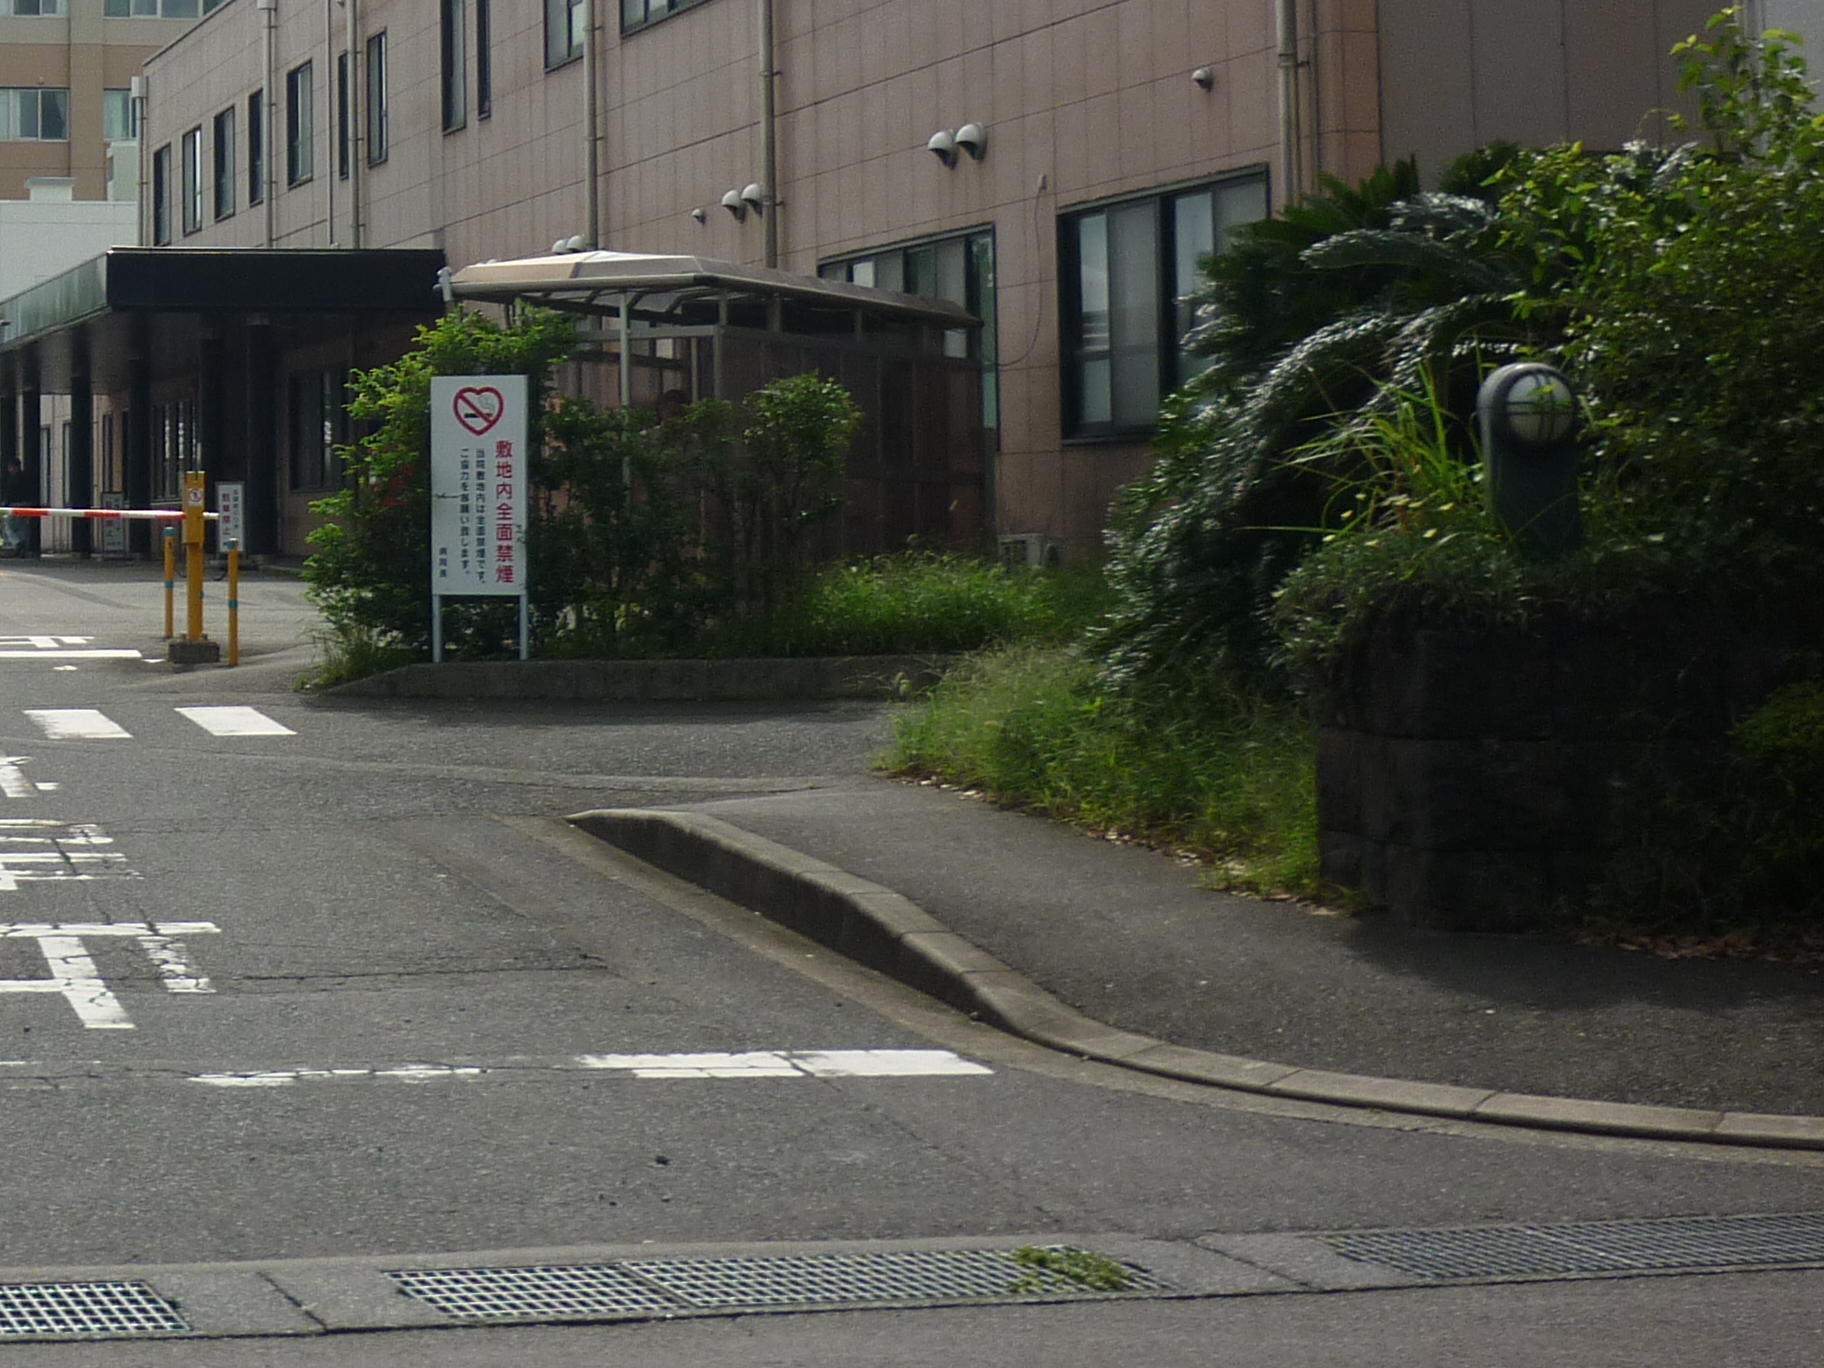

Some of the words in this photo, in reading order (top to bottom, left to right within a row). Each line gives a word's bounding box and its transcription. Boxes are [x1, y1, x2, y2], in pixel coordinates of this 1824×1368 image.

[495, 439, 514, 583] 敷地内全面禁煙
